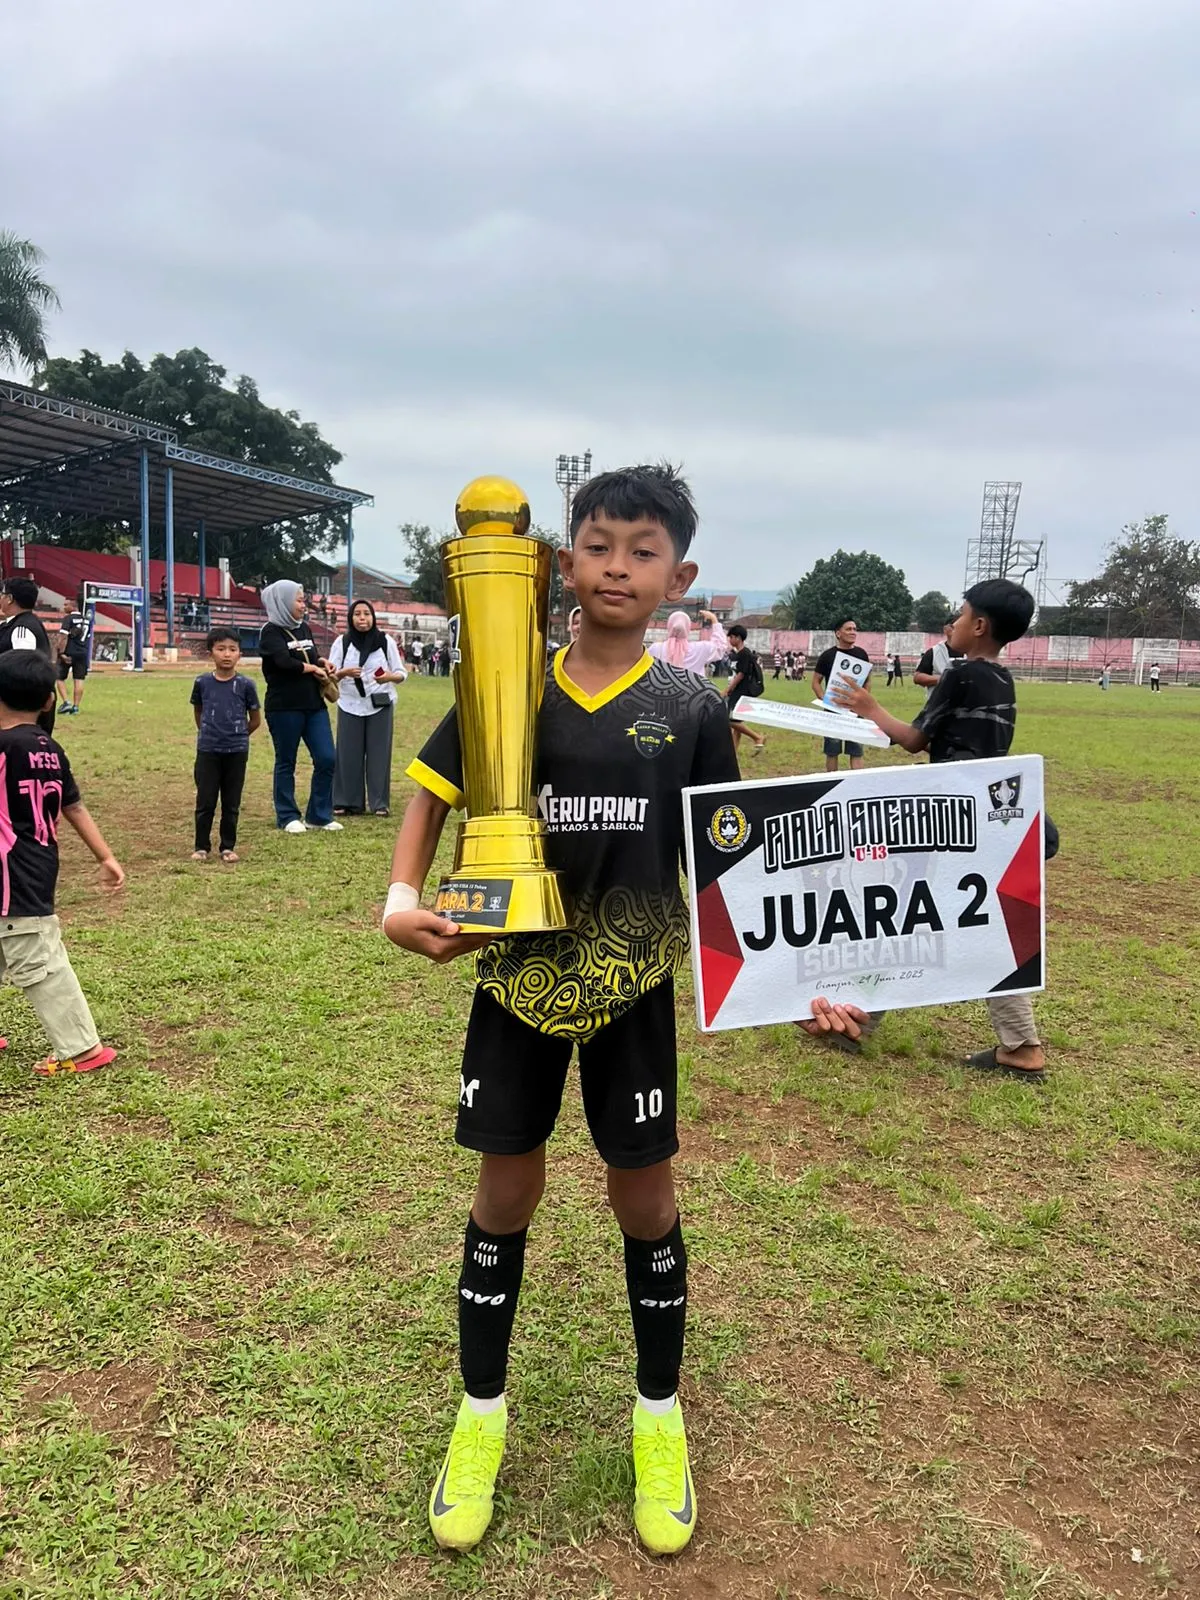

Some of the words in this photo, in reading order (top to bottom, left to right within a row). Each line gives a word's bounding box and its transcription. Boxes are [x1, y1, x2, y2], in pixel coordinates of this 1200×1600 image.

[28, 752, 60, 770] MESSI
[589, 796, 649, 823] PRINT
[547, 825, 559, 833] AH
[561, 823, 589, 832] KAOS
[591, 823, 599, 831] &
[602, 823, 644, 831] SABLON
[764, 802, 844, 873] PIALA
[848, 795, 976, 857] SOERATIN
[855, 845, 888, 862] U-13
[434, 890, 469, 913] UARA
[470, 891, 486, 914] 2
[742, 880, 944, 951] JUARA
[957, 873, 989, 928] 2
[899, 969, 924, 980] 2025
[635, 1088, 663, 1124] 10
